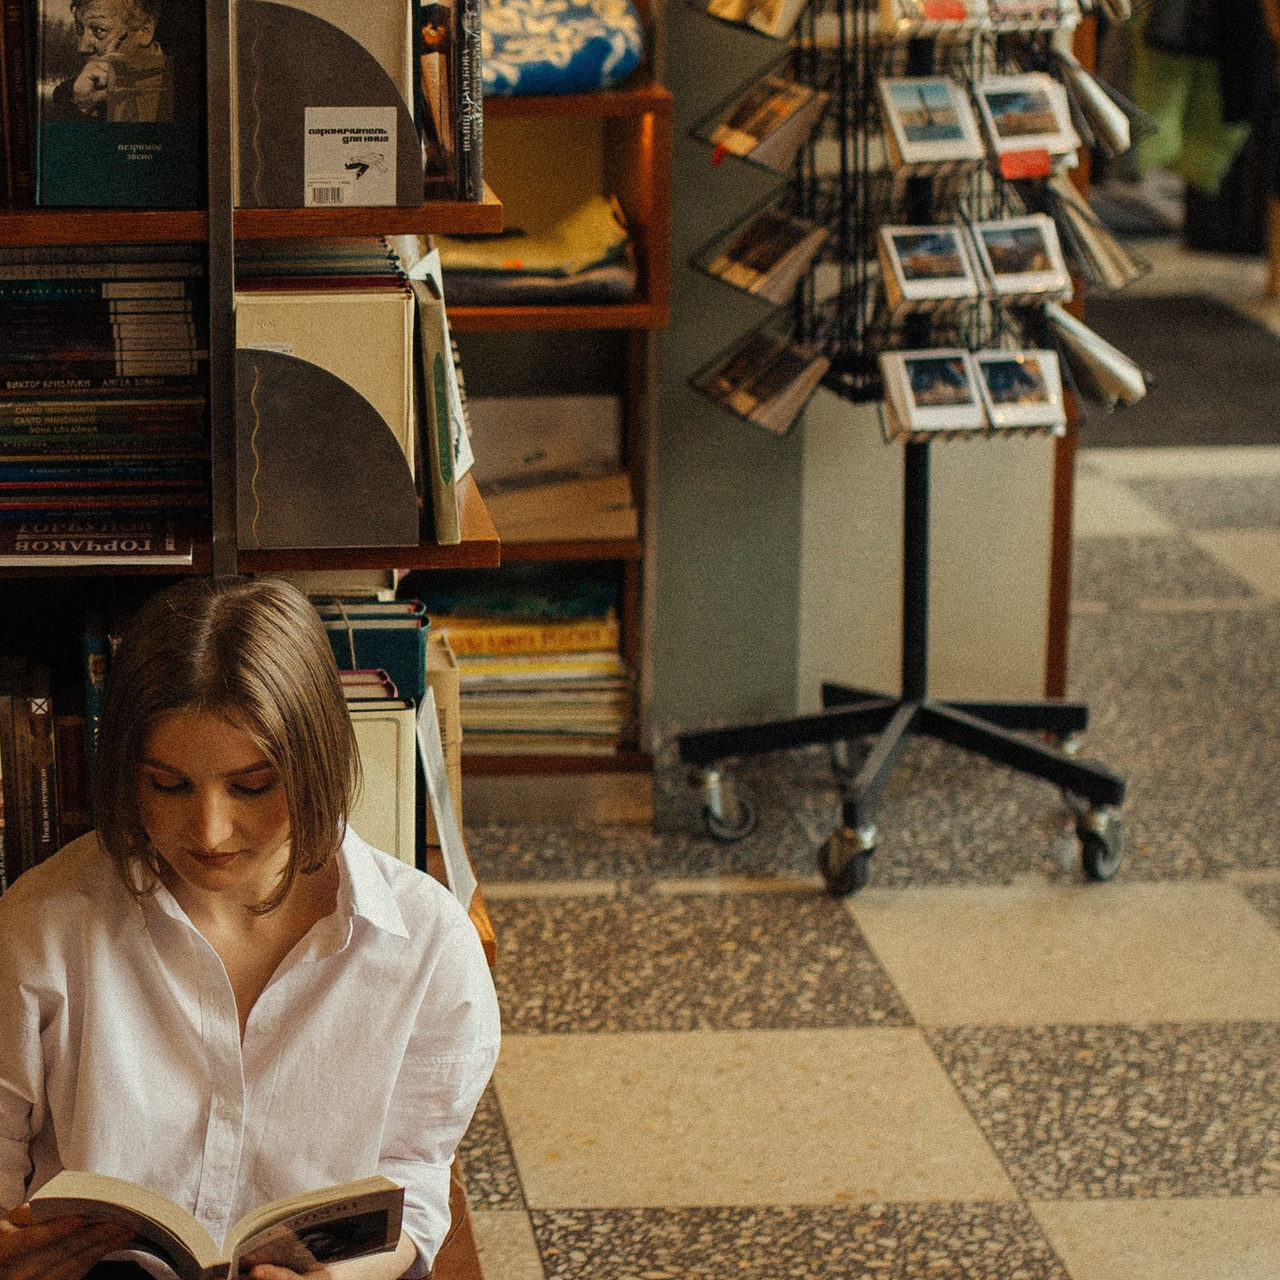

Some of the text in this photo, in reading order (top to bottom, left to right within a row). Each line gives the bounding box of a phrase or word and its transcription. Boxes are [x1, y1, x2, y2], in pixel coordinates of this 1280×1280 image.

[307, 128, 387, 137] ограничитель
[341, 135, 363, 144] для
[13, 539, 153, 553] ГОРЧАКОВ
